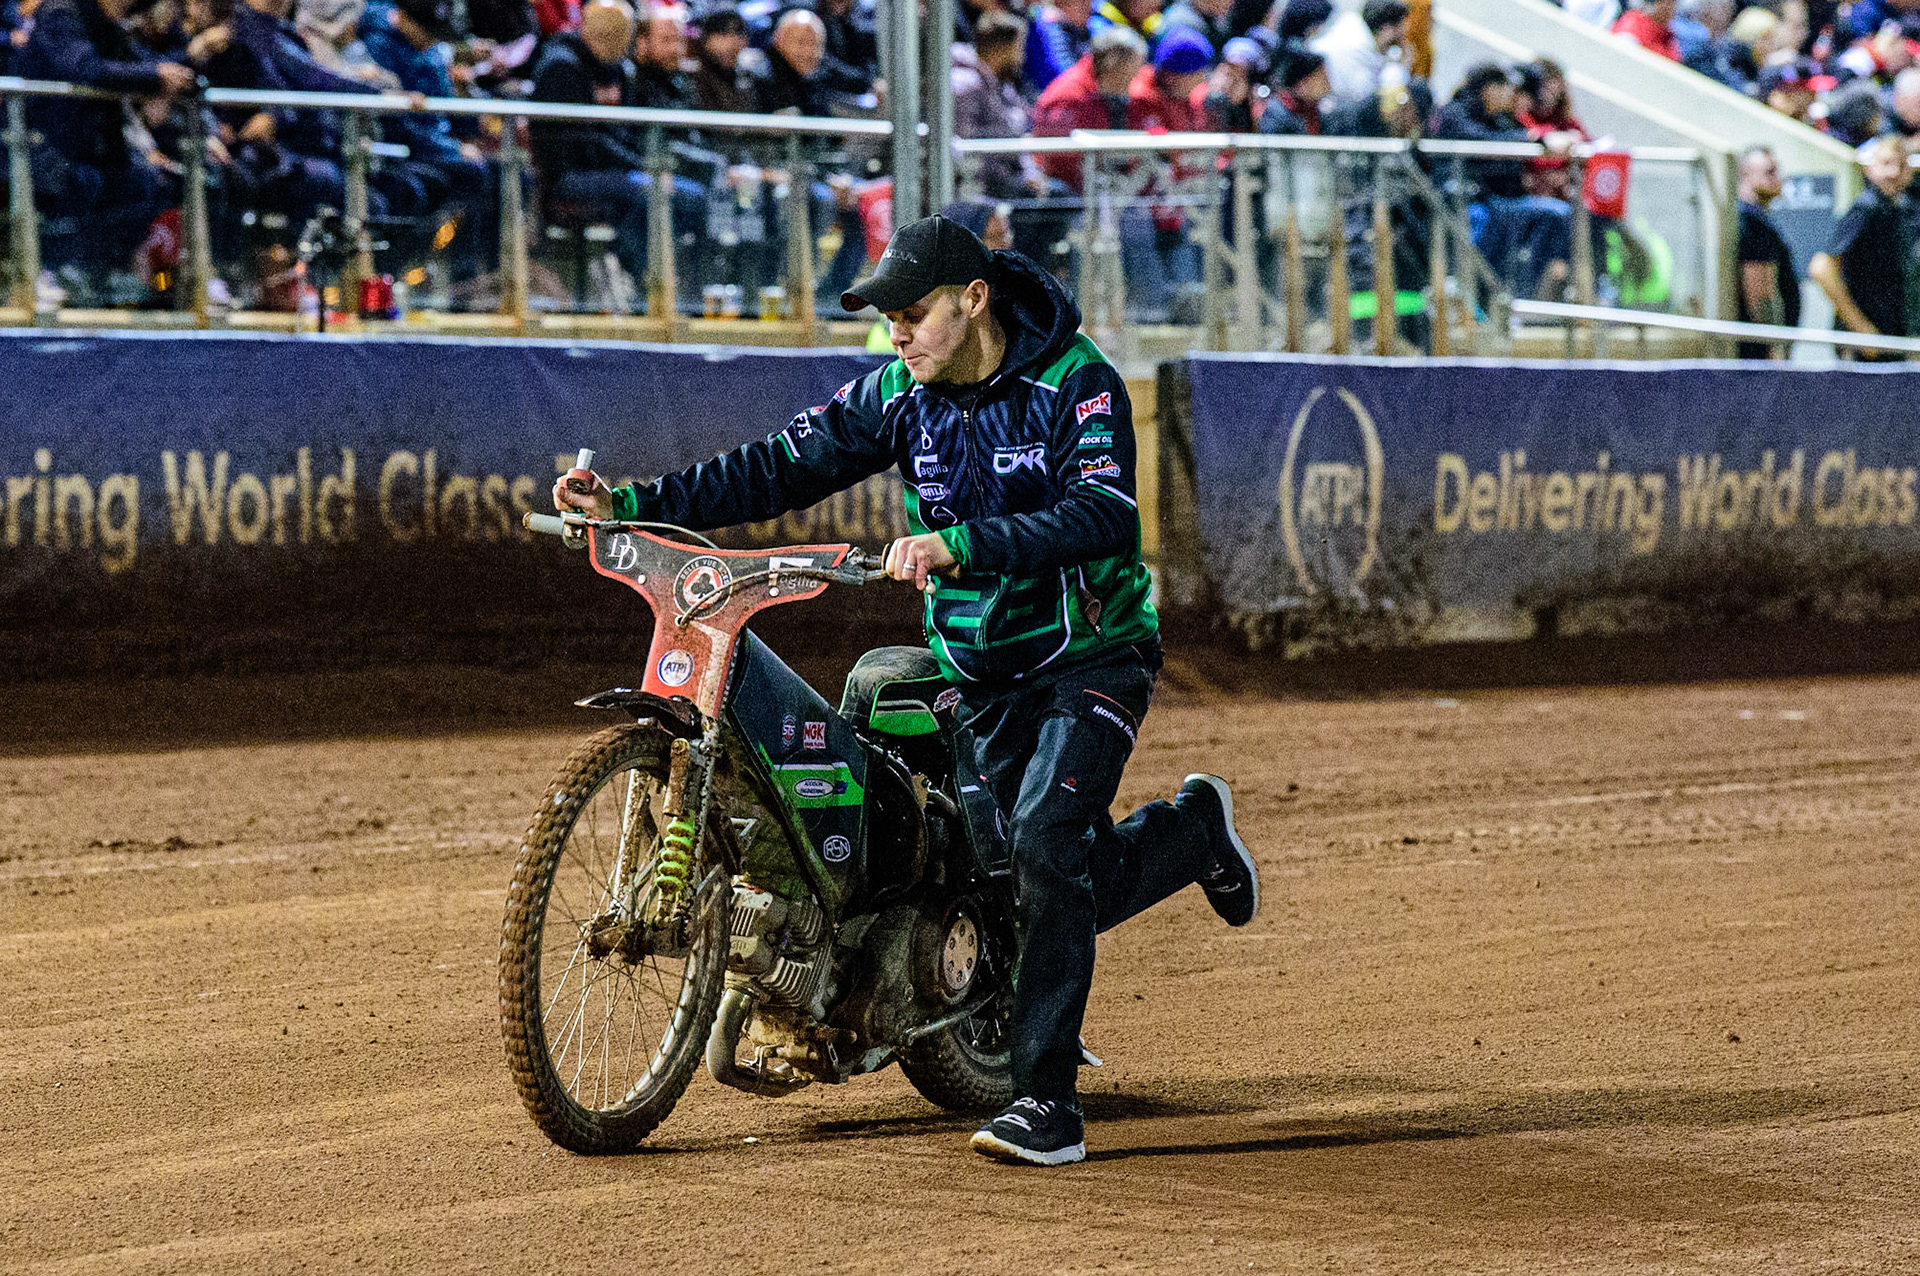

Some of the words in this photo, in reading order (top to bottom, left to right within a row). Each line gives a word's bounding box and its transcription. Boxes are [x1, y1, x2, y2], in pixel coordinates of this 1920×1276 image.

[1079, 436, 1101, 445] ROCK
[0, 448, 141, 573] ring
[160, 447, 357, 547] World
[378, 447, 537, 544] Class
[1434, 448, 1666, 554] Delivering
[1677, 447, 1805, 530] World
[1812, 448, 1918, 527] Class
[1092, 704, 1125, 728] Honda
[803, 723, 825, 741] NGK
